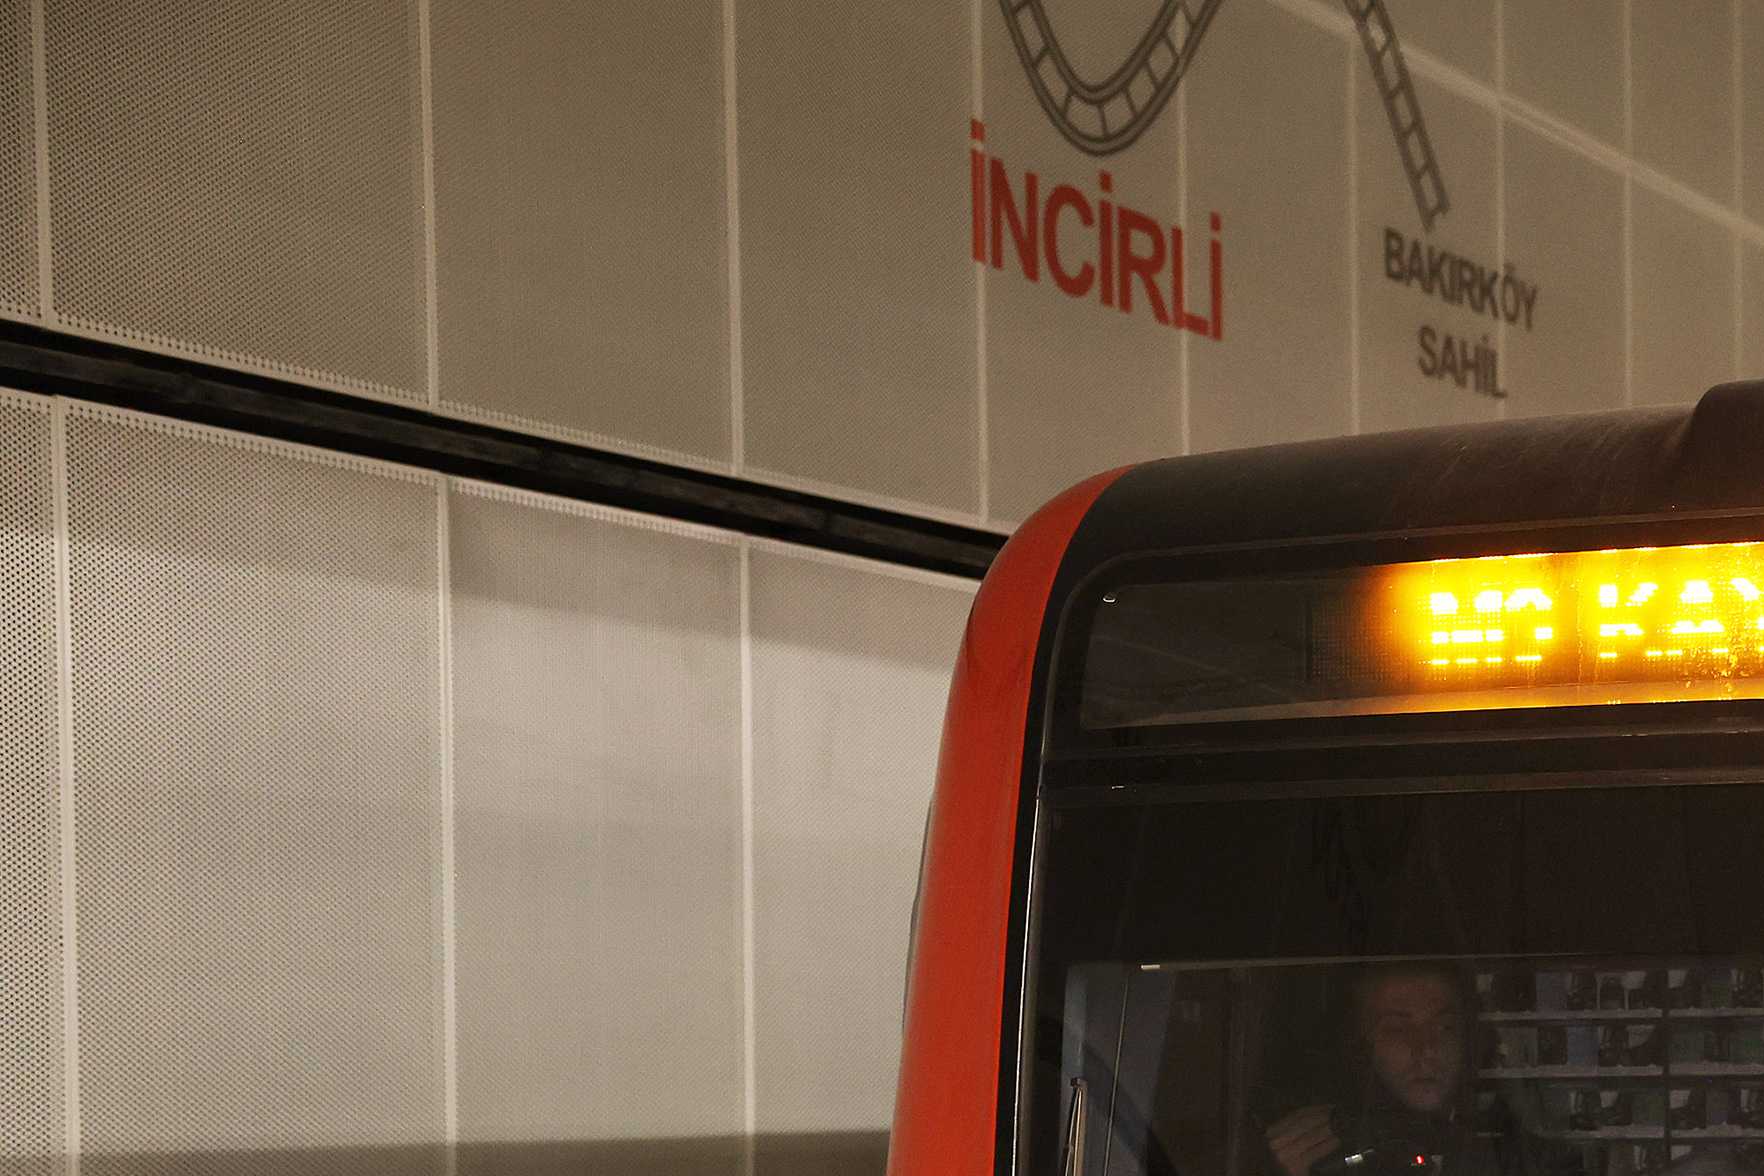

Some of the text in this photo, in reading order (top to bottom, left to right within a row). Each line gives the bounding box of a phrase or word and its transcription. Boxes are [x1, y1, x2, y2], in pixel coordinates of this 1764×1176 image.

[970, 118, 1223, 341] İNCİRLİ
[1383, 229, 1537, 331] BAKIRKÖY
[1417, 324, 1508, 398] SAHİL
